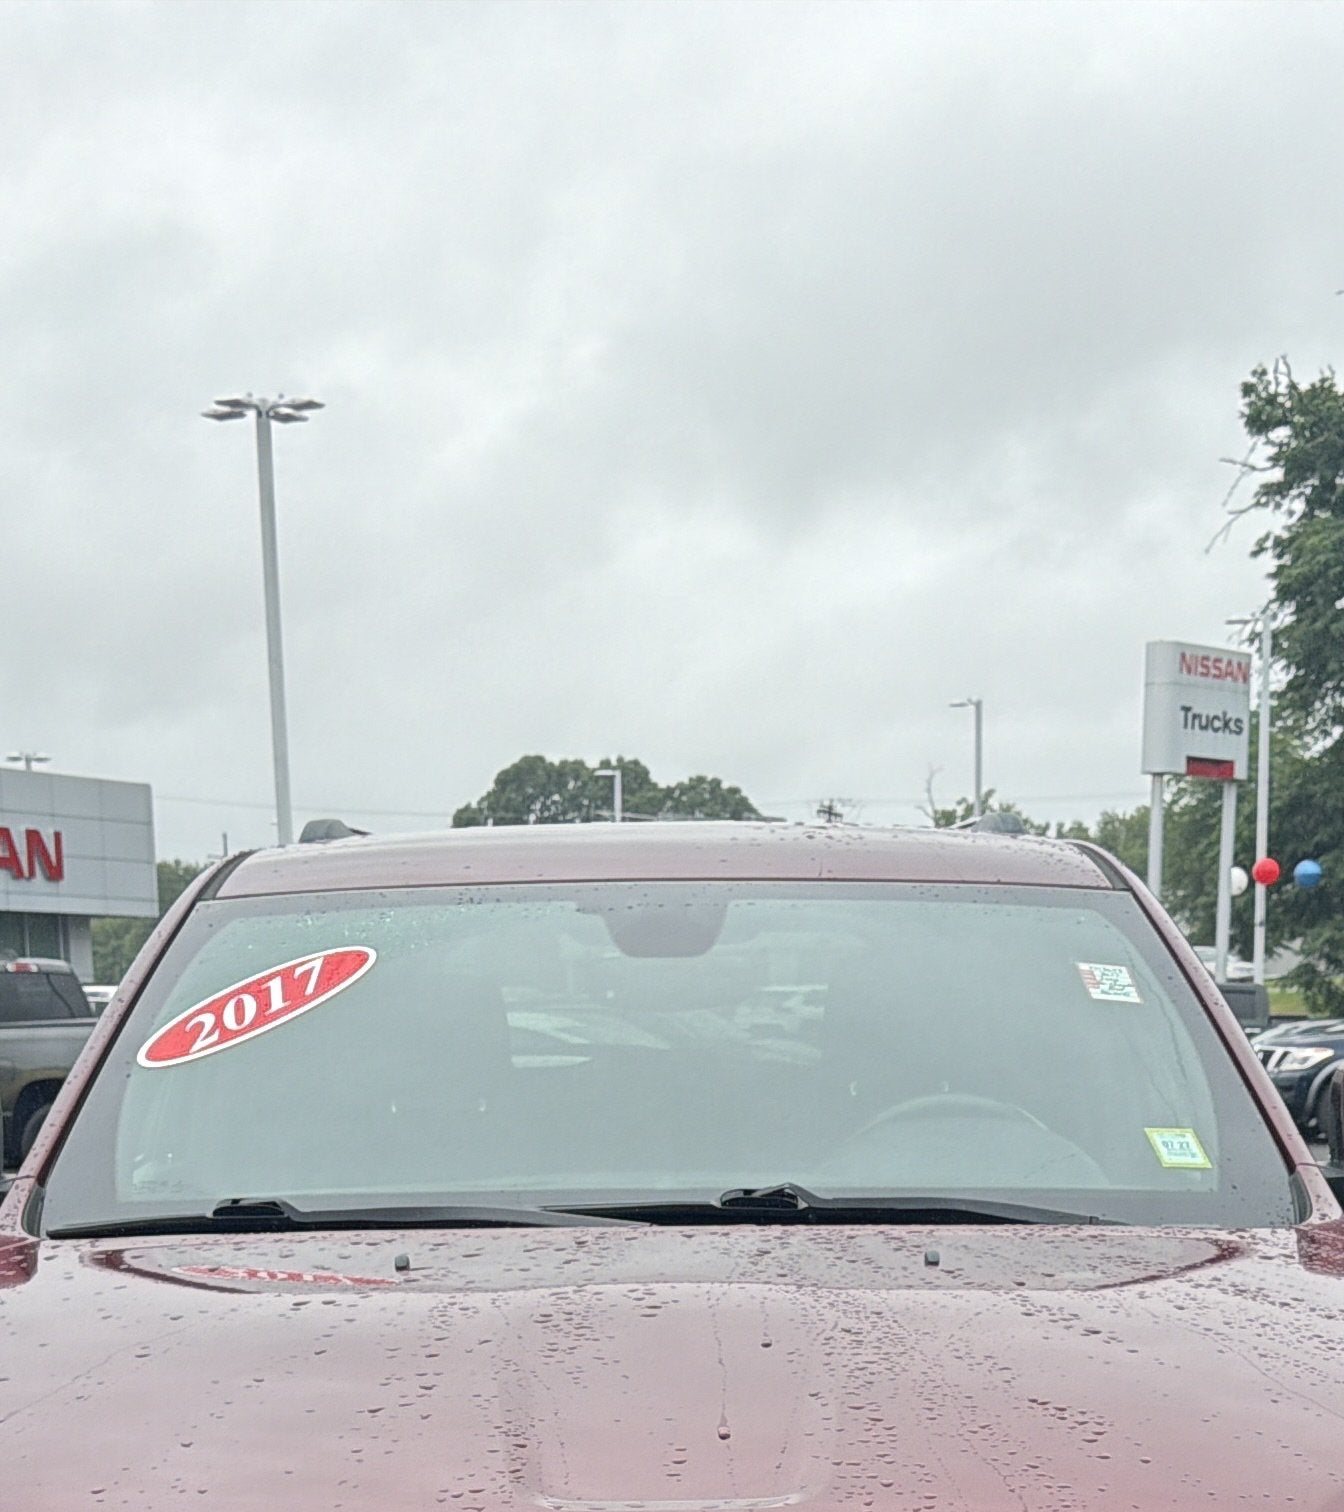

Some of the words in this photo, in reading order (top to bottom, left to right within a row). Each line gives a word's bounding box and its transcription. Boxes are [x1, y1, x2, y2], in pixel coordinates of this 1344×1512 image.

[1179, 651, 1248, 684] NISSAN
[1181, 705, 1244, 735] Trucks
[184, 956, 325, 1054] 2017
